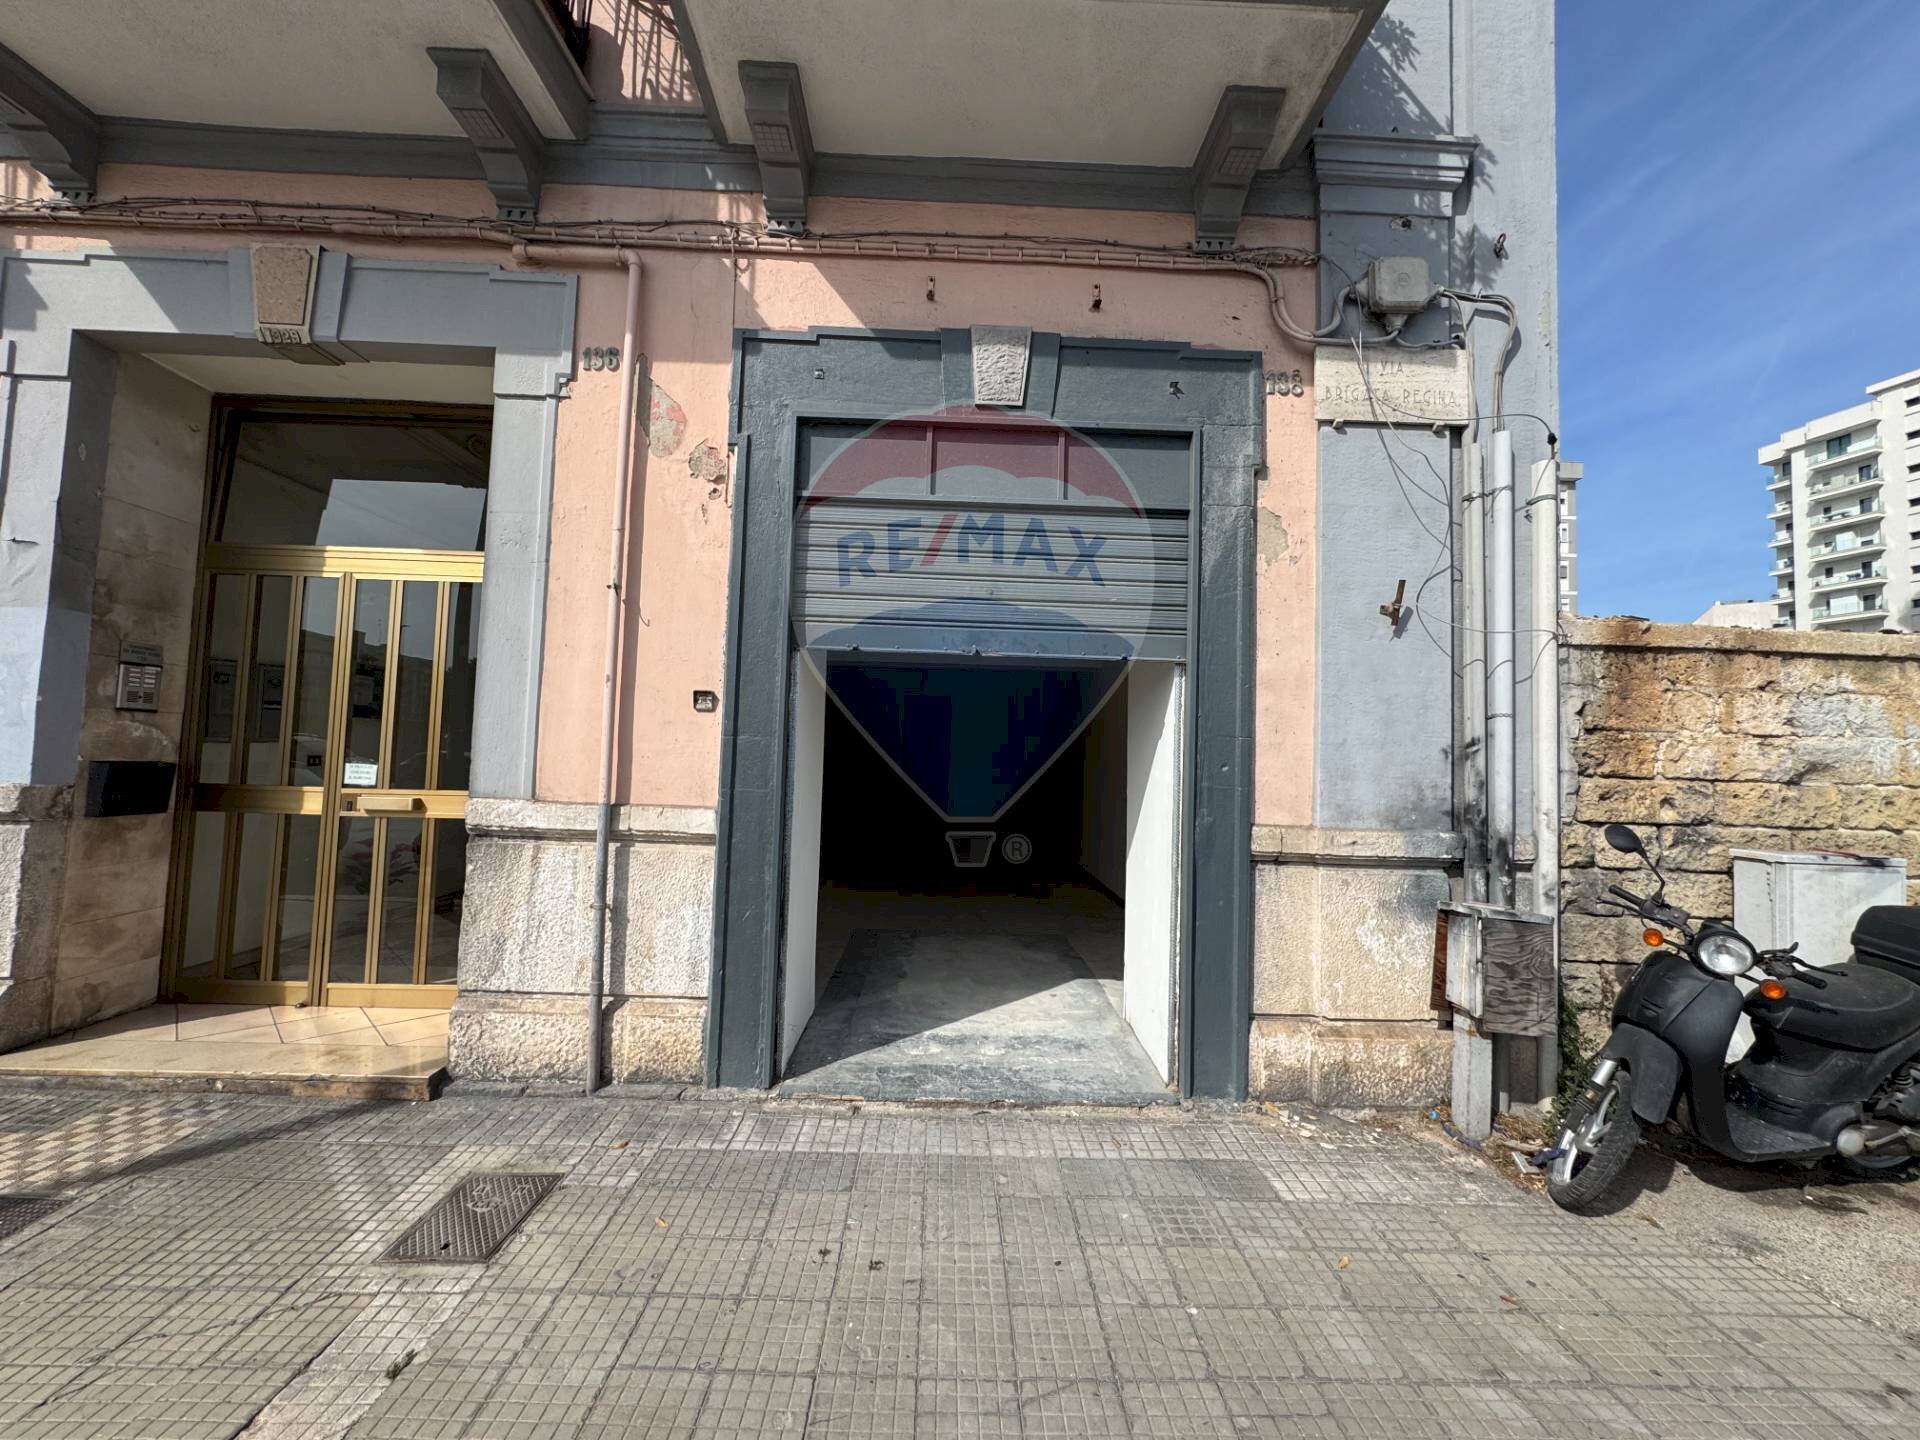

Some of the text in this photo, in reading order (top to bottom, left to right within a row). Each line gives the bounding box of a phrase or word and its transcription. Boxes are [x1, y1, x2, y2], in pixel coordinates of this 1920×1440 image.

[583, 346, 620, 372] 136
[1380, 361, 1404, 376] VIA
[1402, 388, 1458, 407] REGINA
